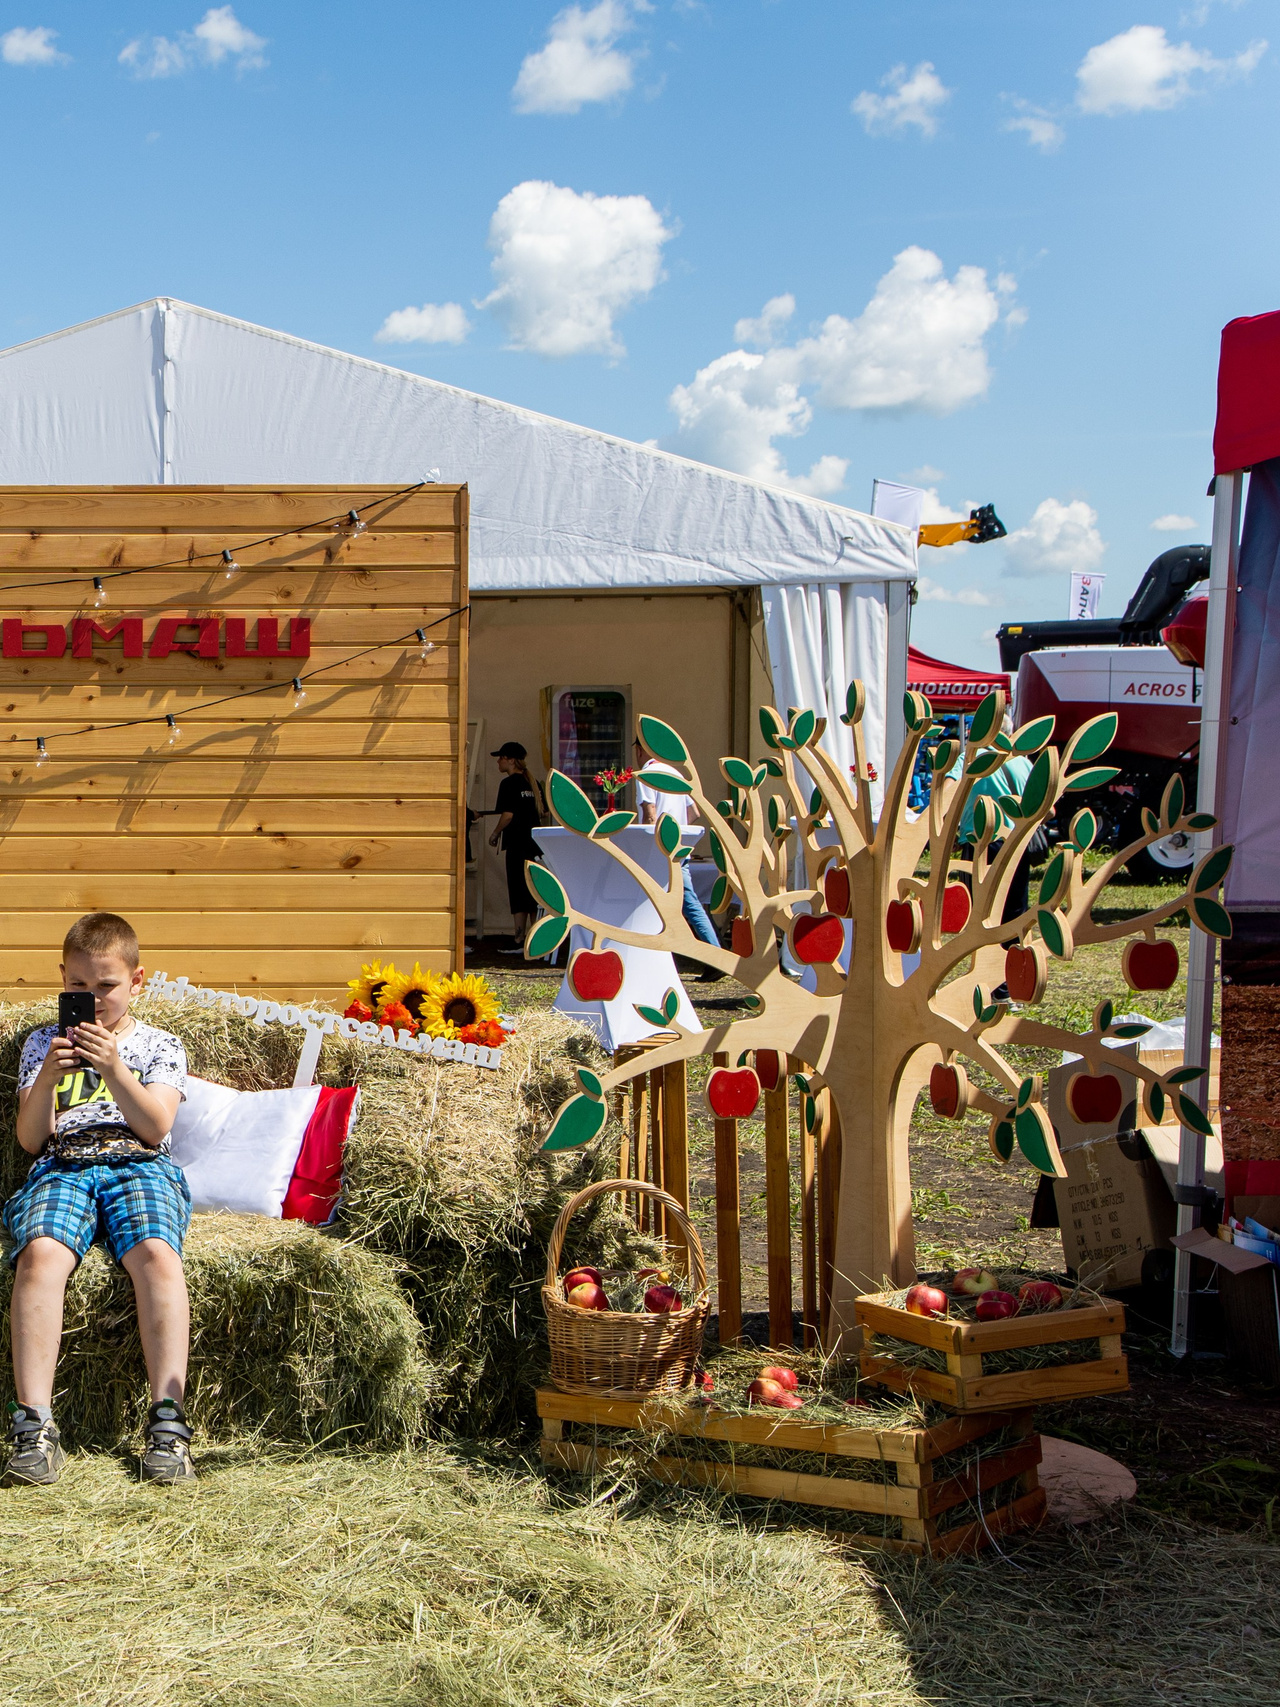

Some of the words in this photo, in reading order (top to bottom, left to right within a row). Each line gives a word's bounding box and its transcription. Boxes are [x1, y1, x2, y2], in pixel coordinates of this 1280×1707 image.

[907, 682, 1003, 695] ионалов
[1123, 683, 1187, 697] ACROS
[145, 970, 504, 1070] #фоторостсельмаш
